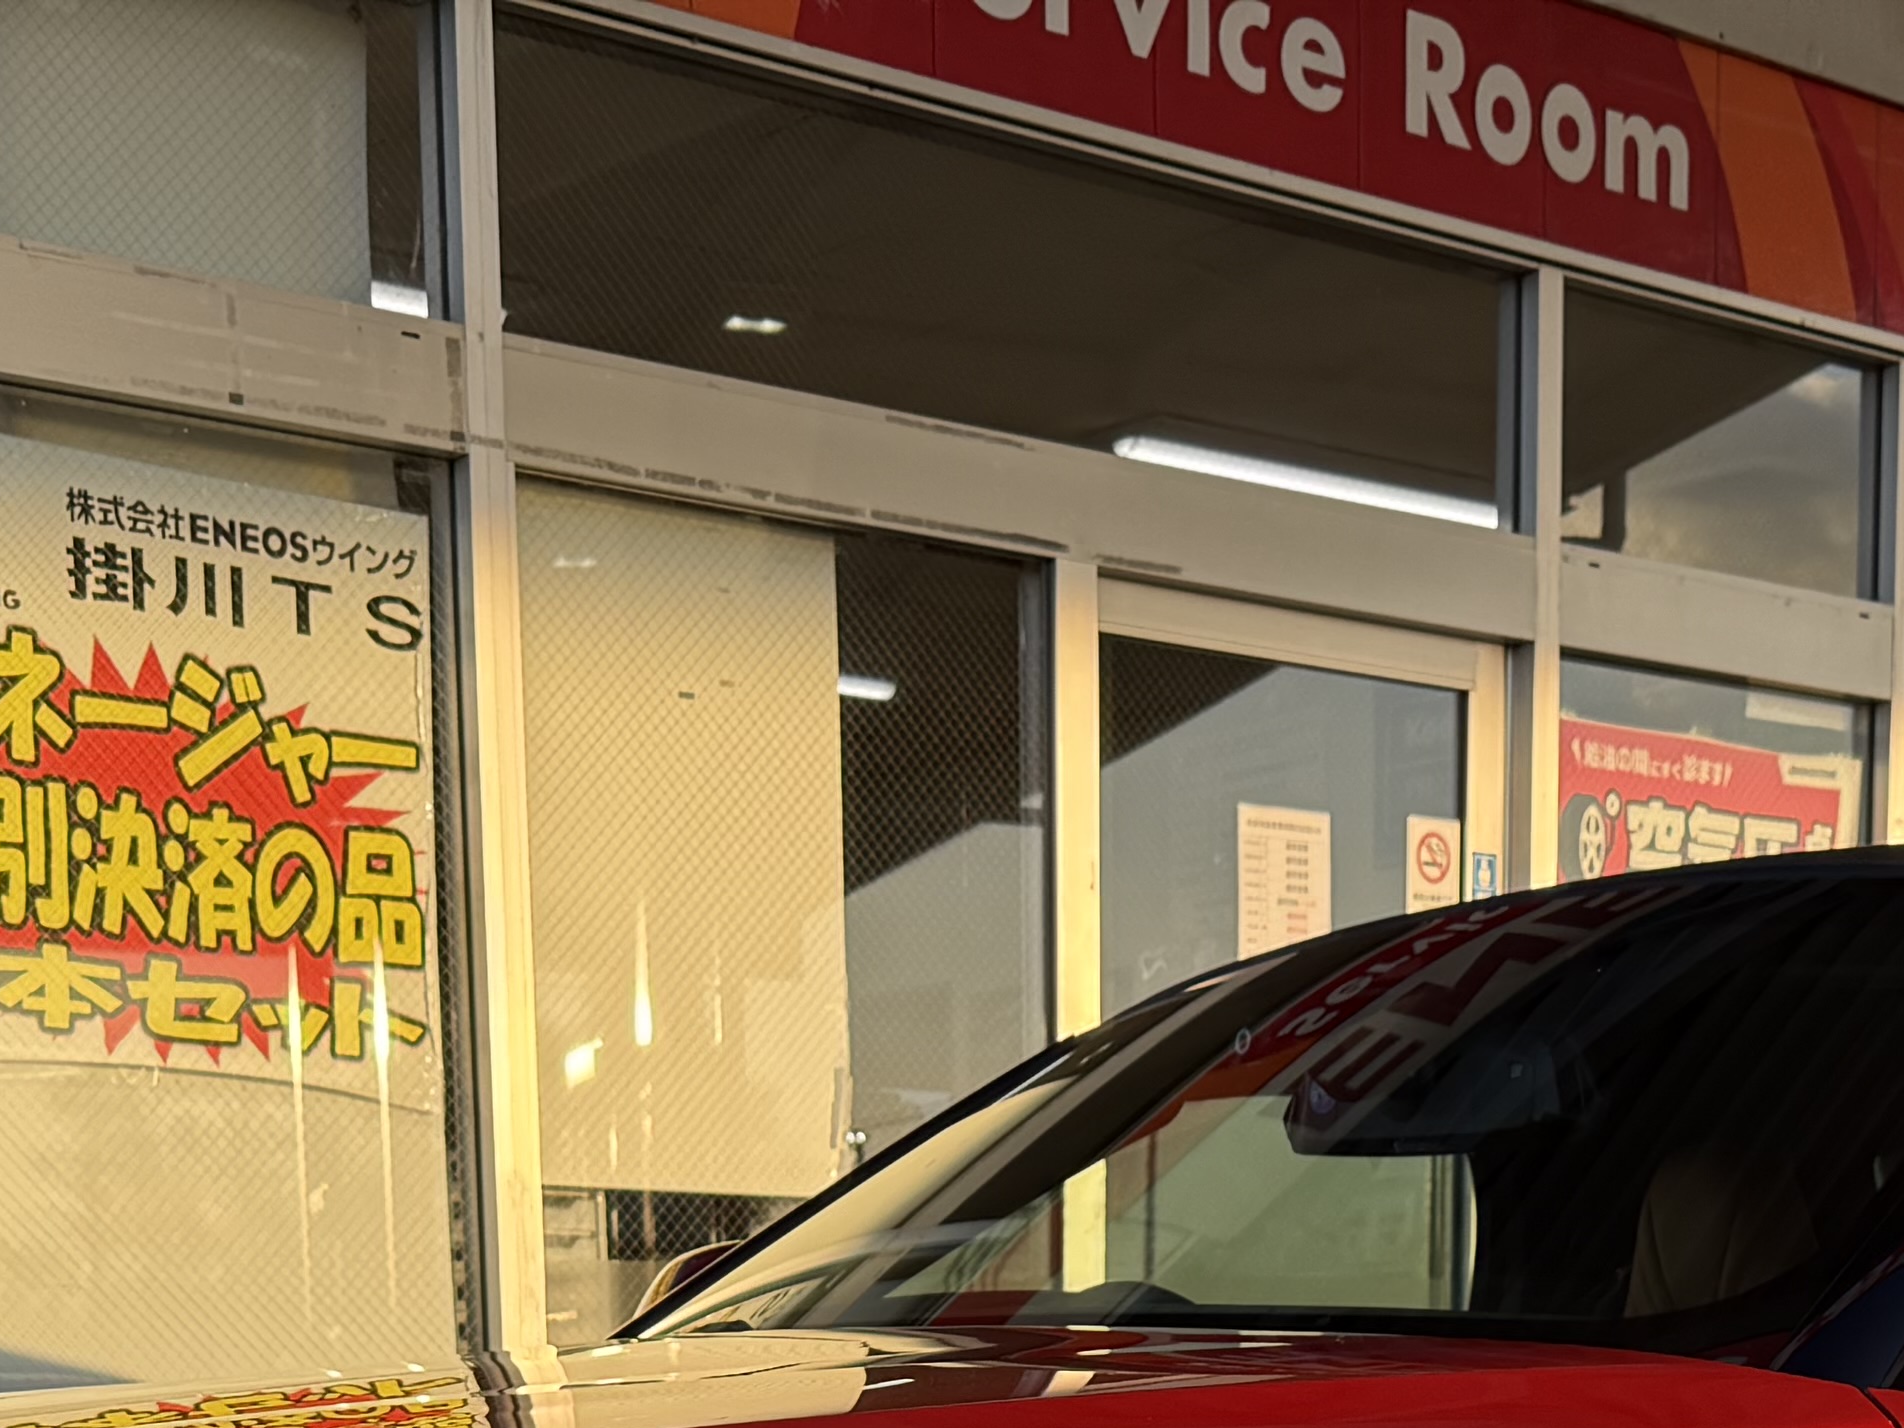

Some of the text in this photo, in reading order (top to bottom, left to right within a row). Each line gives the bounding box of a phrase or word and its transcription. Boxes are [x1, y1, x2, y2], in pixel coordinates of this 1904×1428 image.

[1405, 9, 1690, 212] Room
[65, 486, 418, 581] 株式会社ENEOSウイング
